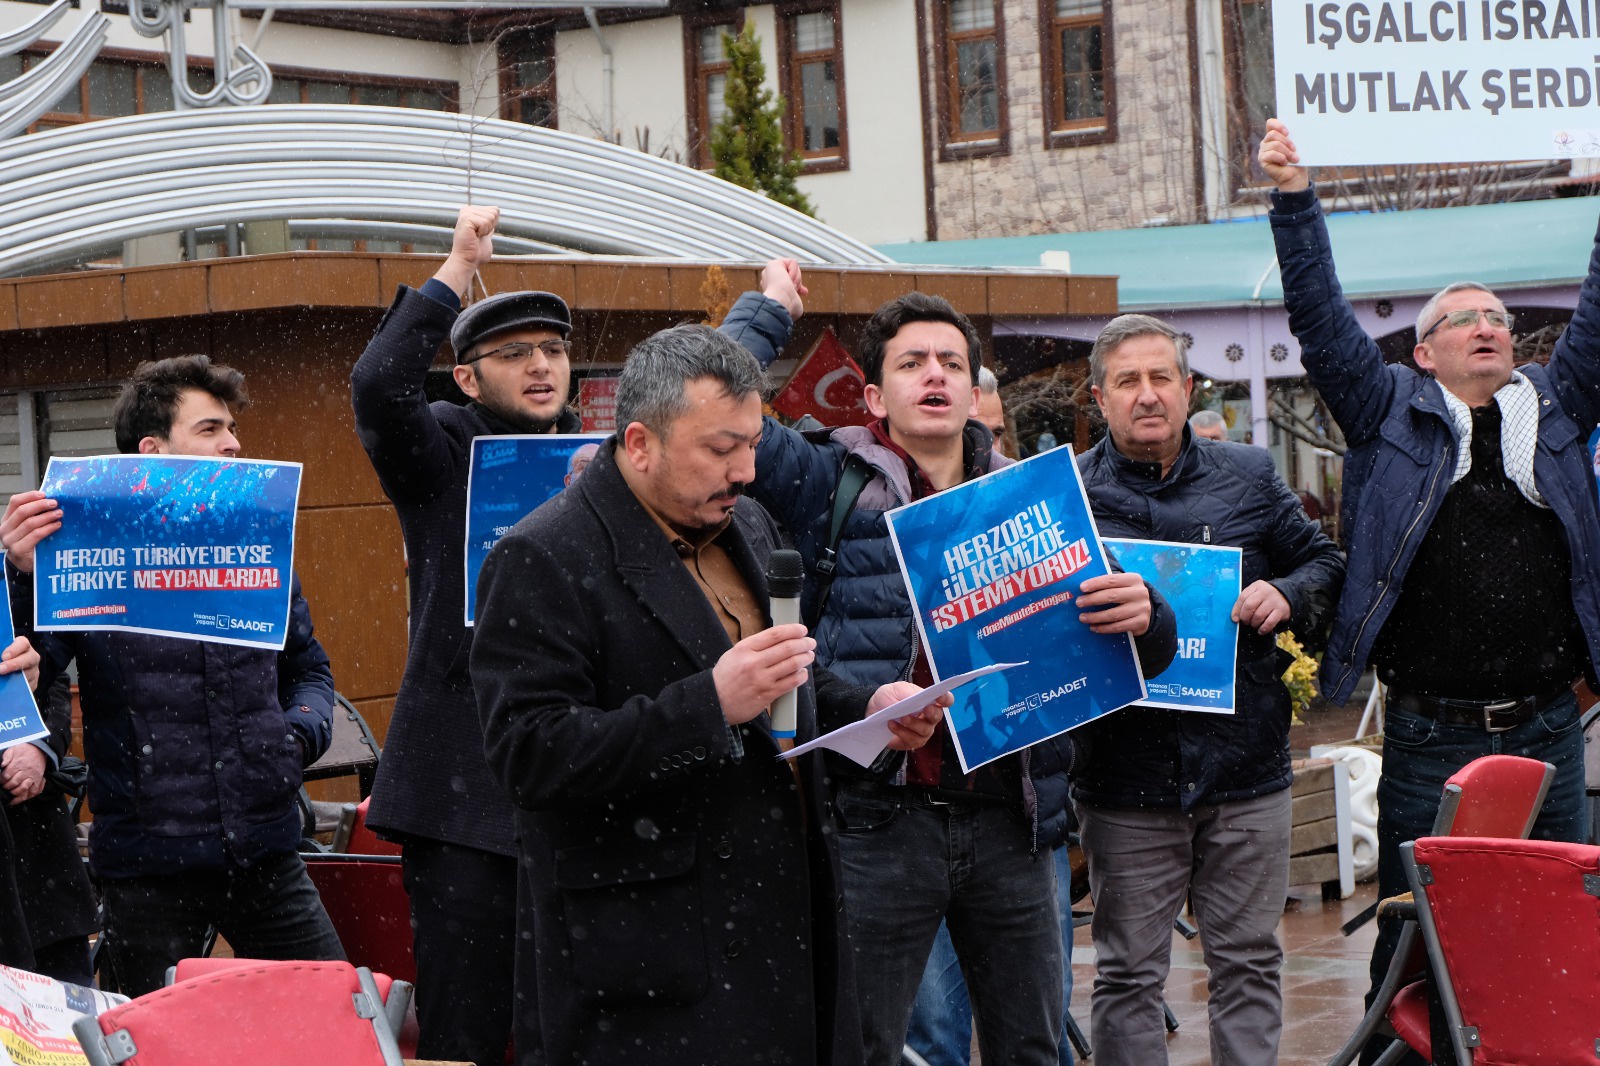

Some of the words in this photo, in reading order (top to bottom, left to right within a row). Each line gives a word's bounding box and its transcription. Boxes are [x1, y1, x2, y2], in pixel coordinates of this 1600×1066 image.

[1295, 69, 1471, 114] MUTLAK
[943, 500, 1052, 574] HERZOG'U
[55, 547, 125, 570] HERZOG
[132, 543, 273, 567] TÜRKİYE'DEYSE
[942, 521, 1069, 602] ÜLKEMİZDE
[48, 568, 127, 594] TÜRKİYE
[133, 568, 279, 589] MEYDANLARDA!
[932, 537, 1093, 633] İSTEMİYORUZ!
[230, 618, 274, 633] SAADET
[1176, 637, 1206, 659] AR!
[1041, 676, 1087, 703] SAADET
[1181, 686, 1223, 699] SAADET
[1001, 701, 1026, 714] insanca
